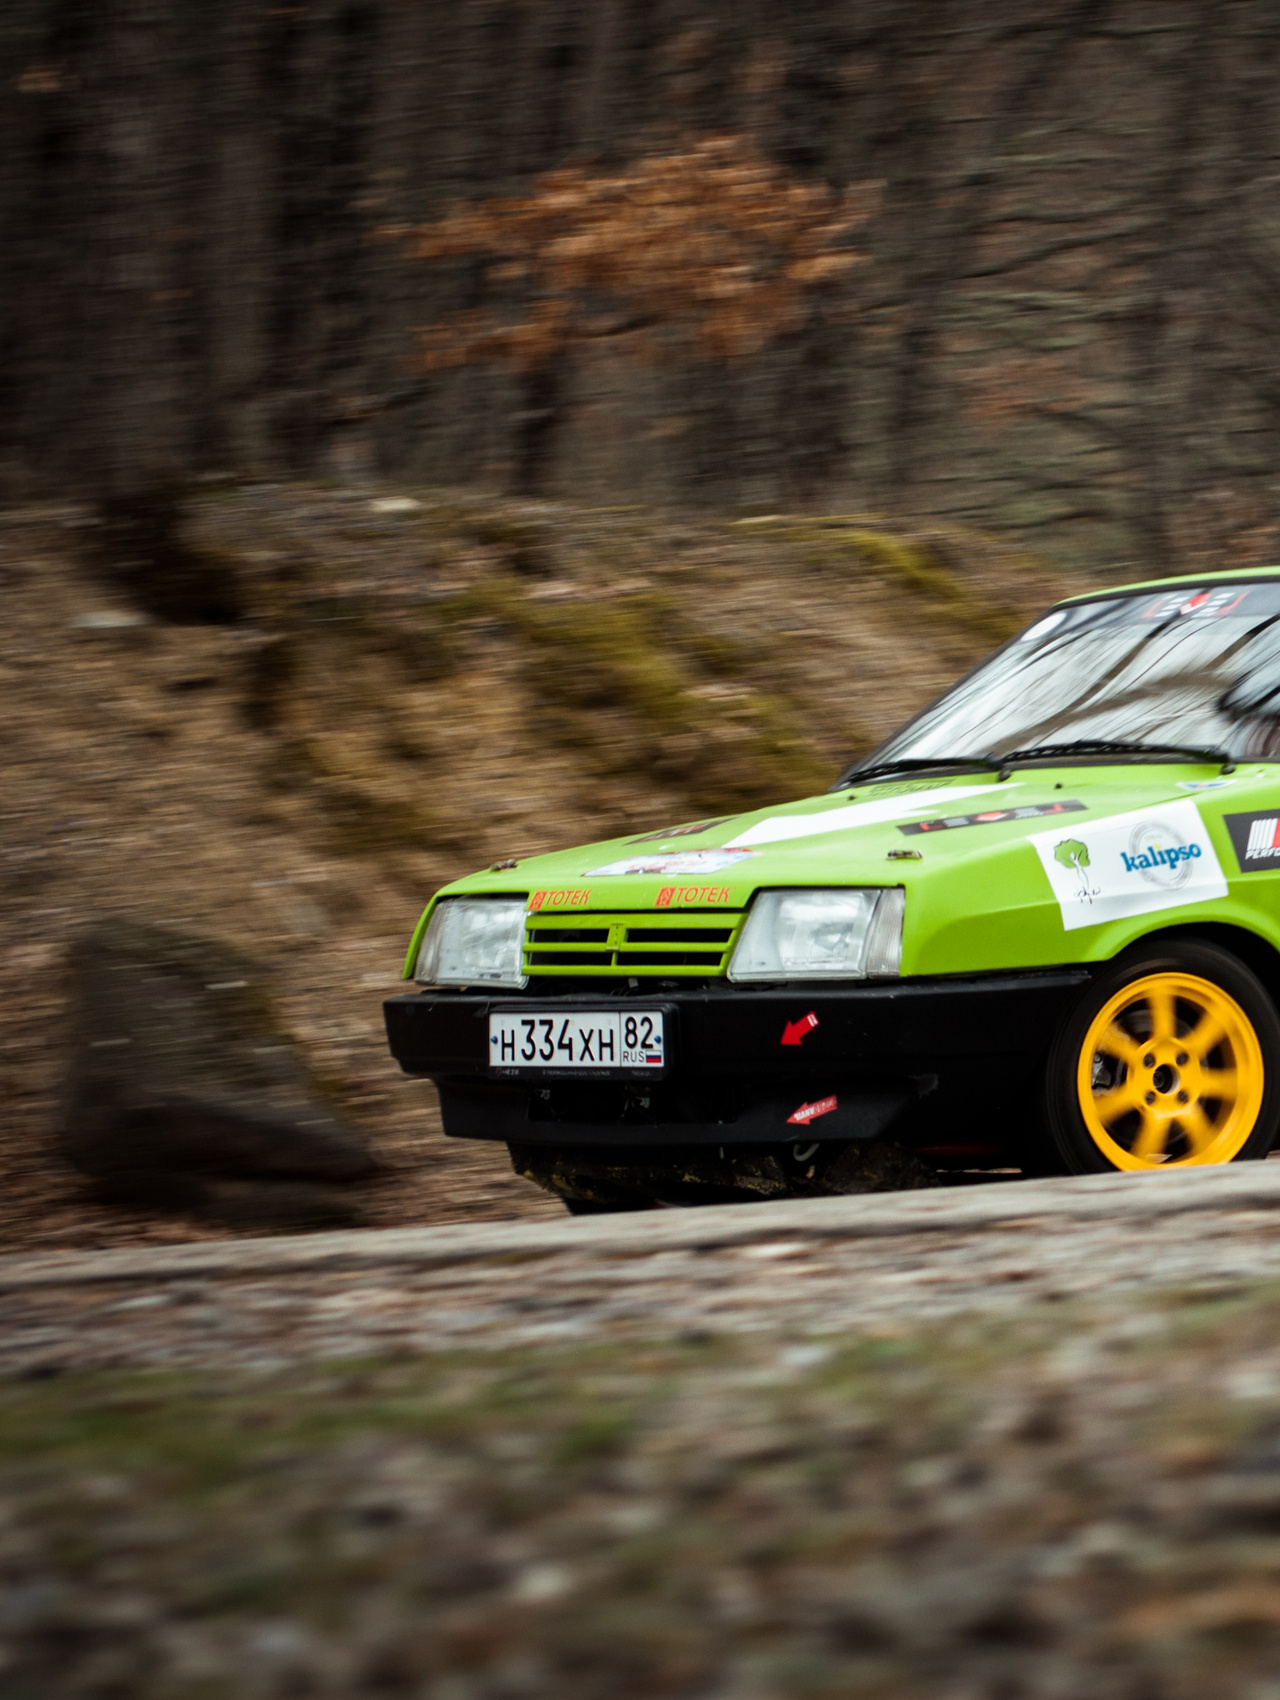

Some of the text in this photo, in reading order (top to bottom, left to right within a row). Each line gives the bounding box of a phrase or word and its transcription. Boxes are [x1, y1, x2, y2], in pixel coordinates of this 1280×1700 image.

[1120, 842, 1202, 872] kalipso
[624, 1016, 654, 1049] 82
[622, 1051, 645, 1063] RUS
